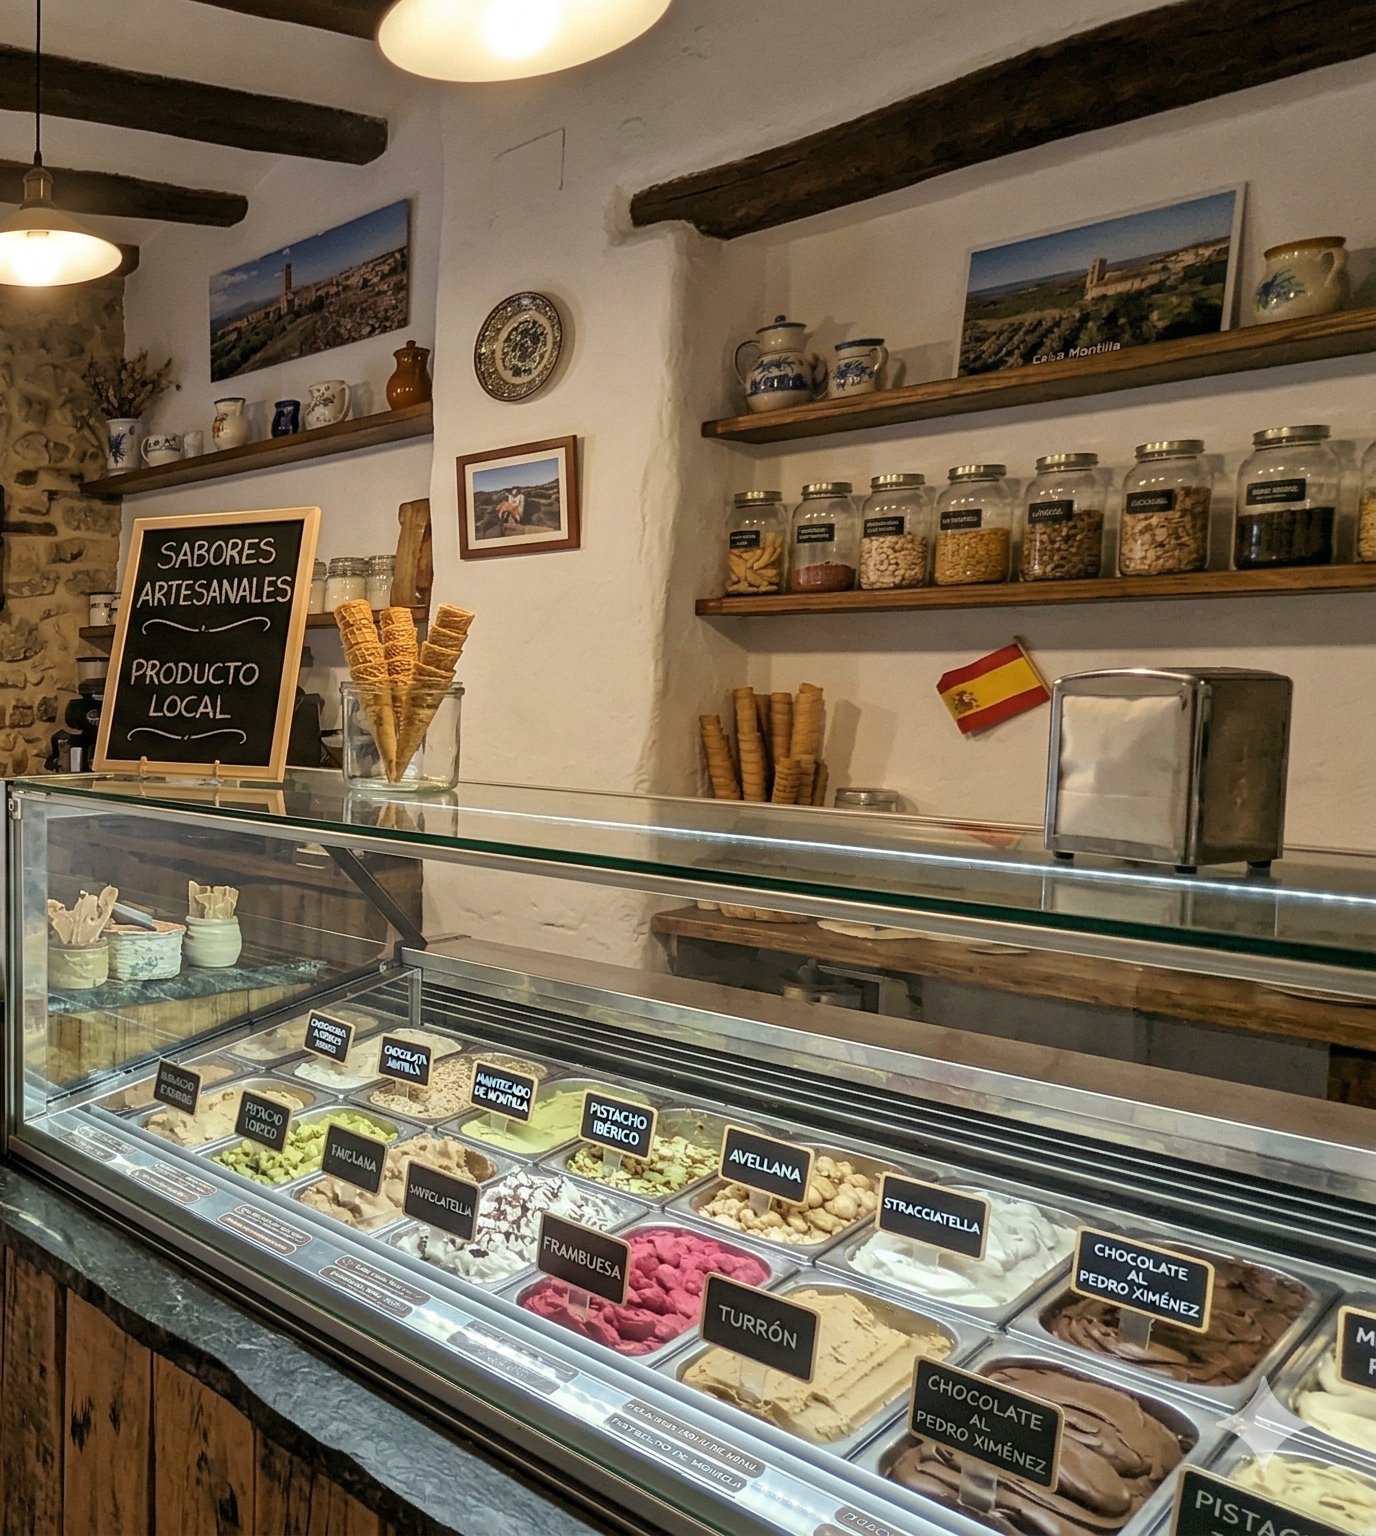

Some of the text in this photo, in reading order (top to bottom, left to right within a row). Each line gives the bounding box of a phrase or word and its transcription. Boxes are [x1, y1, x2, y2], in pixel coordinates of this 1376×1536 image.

[157, 538, 276, 569] SABORES
[136, 576, 292, 608] ARTESANALES
[130, 658, 260, 686] PRODUCTO
[148, 694, 231, 719] LOCAL
[590, 1102, 648, 1130] PISTACHO
[593, 1120, 640, 1146] IBÉRICO
[729, 1149, 802, 1184] AVELLANA
[884, 1197, 981, 1235] STRACCIATELLA
[543, 1235, 622, 1280] FRAMBUESA
[1094, 1243, 1189, 1281] CHOCOLATE
[1079, 1270, 1201, 1318] PEDRO XIMÉNEZ
[1127, 1269, 1148, 1286] AL
[718, 1304, 798, 1350] TURRÓN
[928, 1375, 1044, 1432] CHOCOLATE
[969, 1413, 991, 1432] AL
[917, 1410, 1047, 1475] PEDRO XIMÉNEZ
